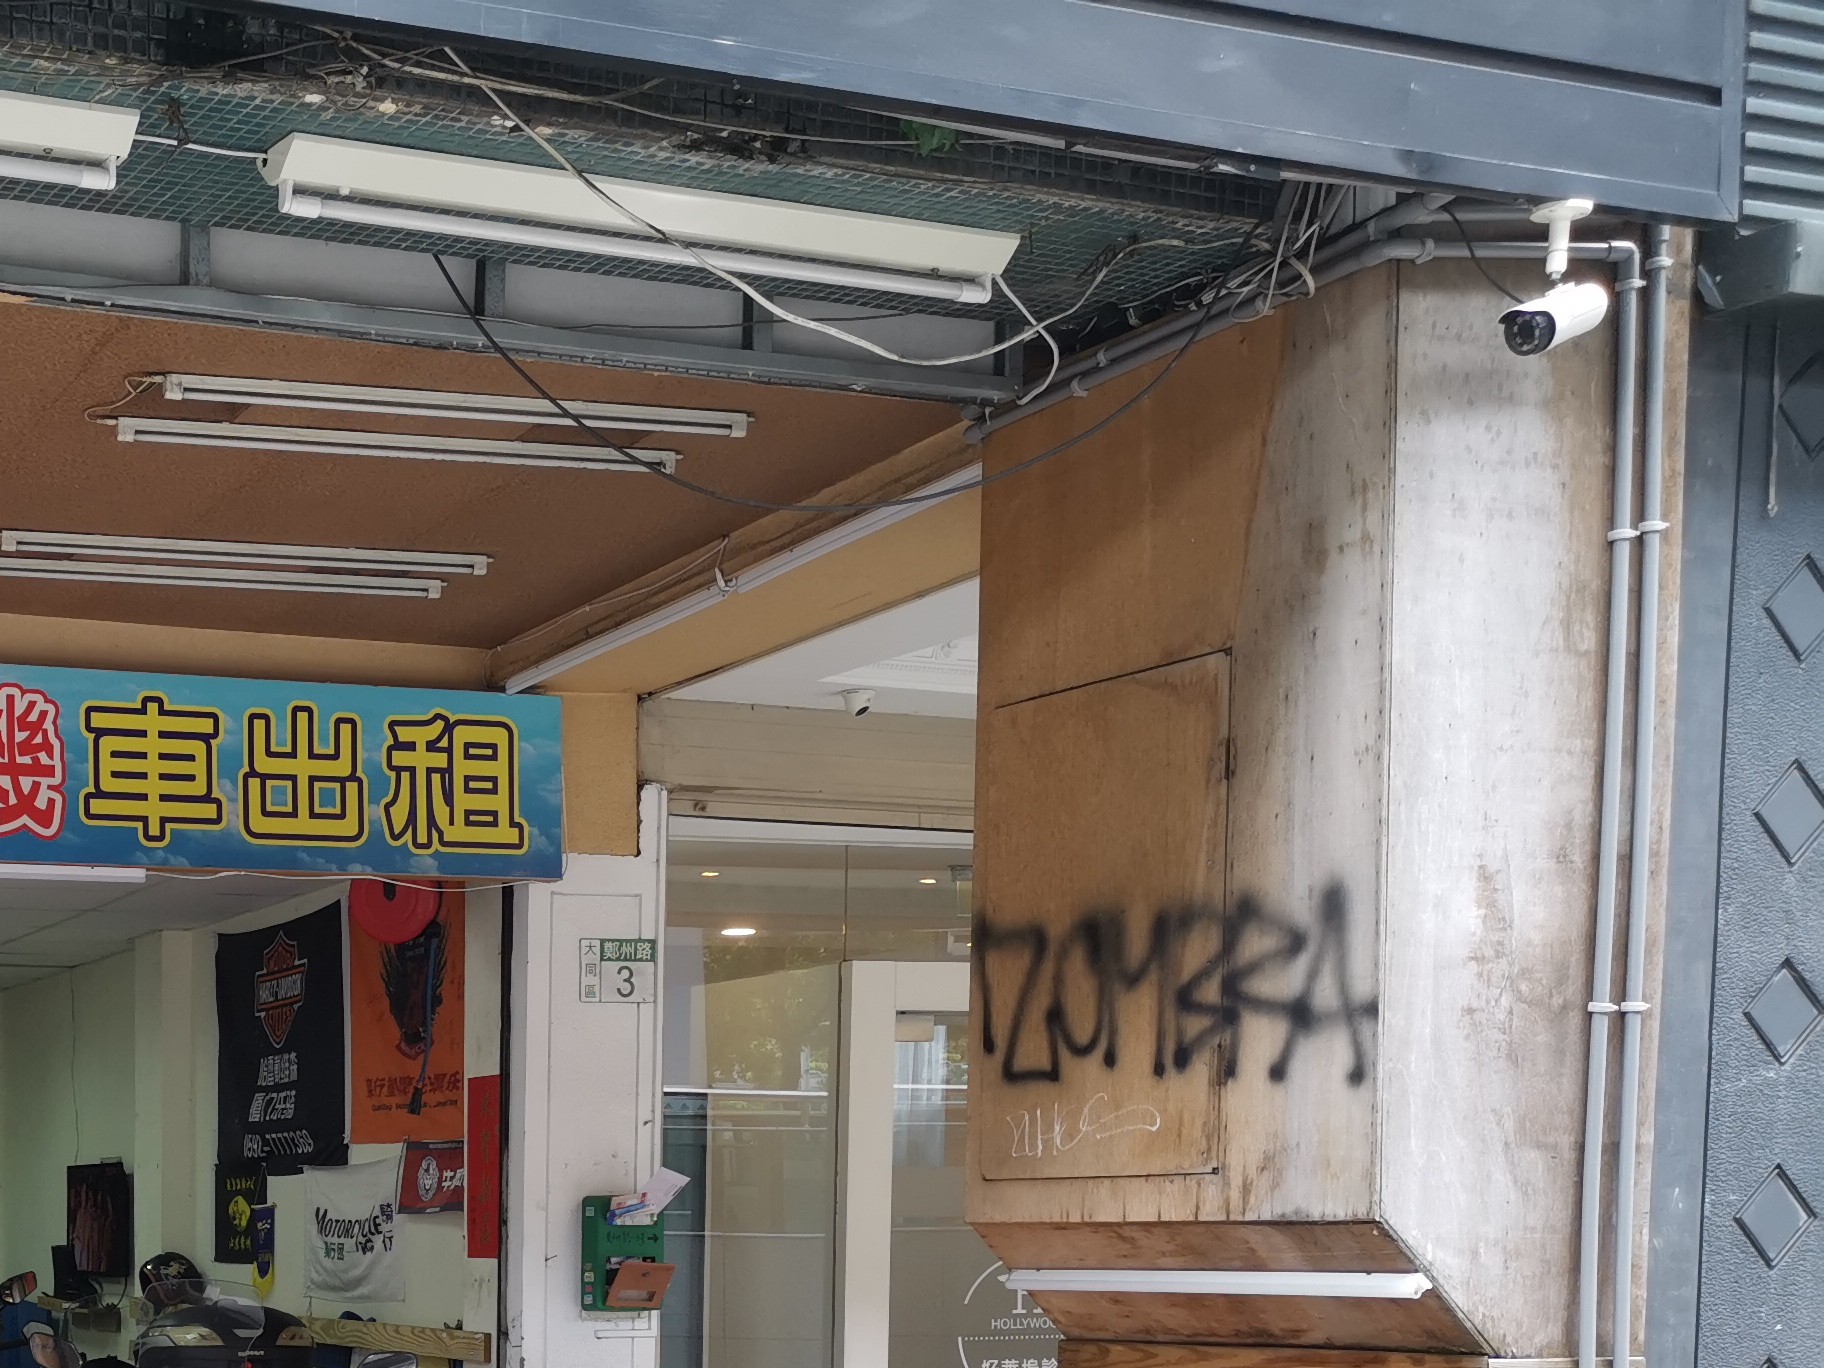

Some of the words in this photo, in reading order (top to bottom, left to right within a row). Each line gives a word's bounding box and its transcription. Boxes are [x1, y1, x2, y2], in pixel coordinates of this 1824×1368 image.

[584, 941, 597, 998] 大同區
[603, 941, 652, 960] 鄭州路
[616, 965, 635, 998] 3
[315, 1205, 383, 1251] MOTORCYCLE
